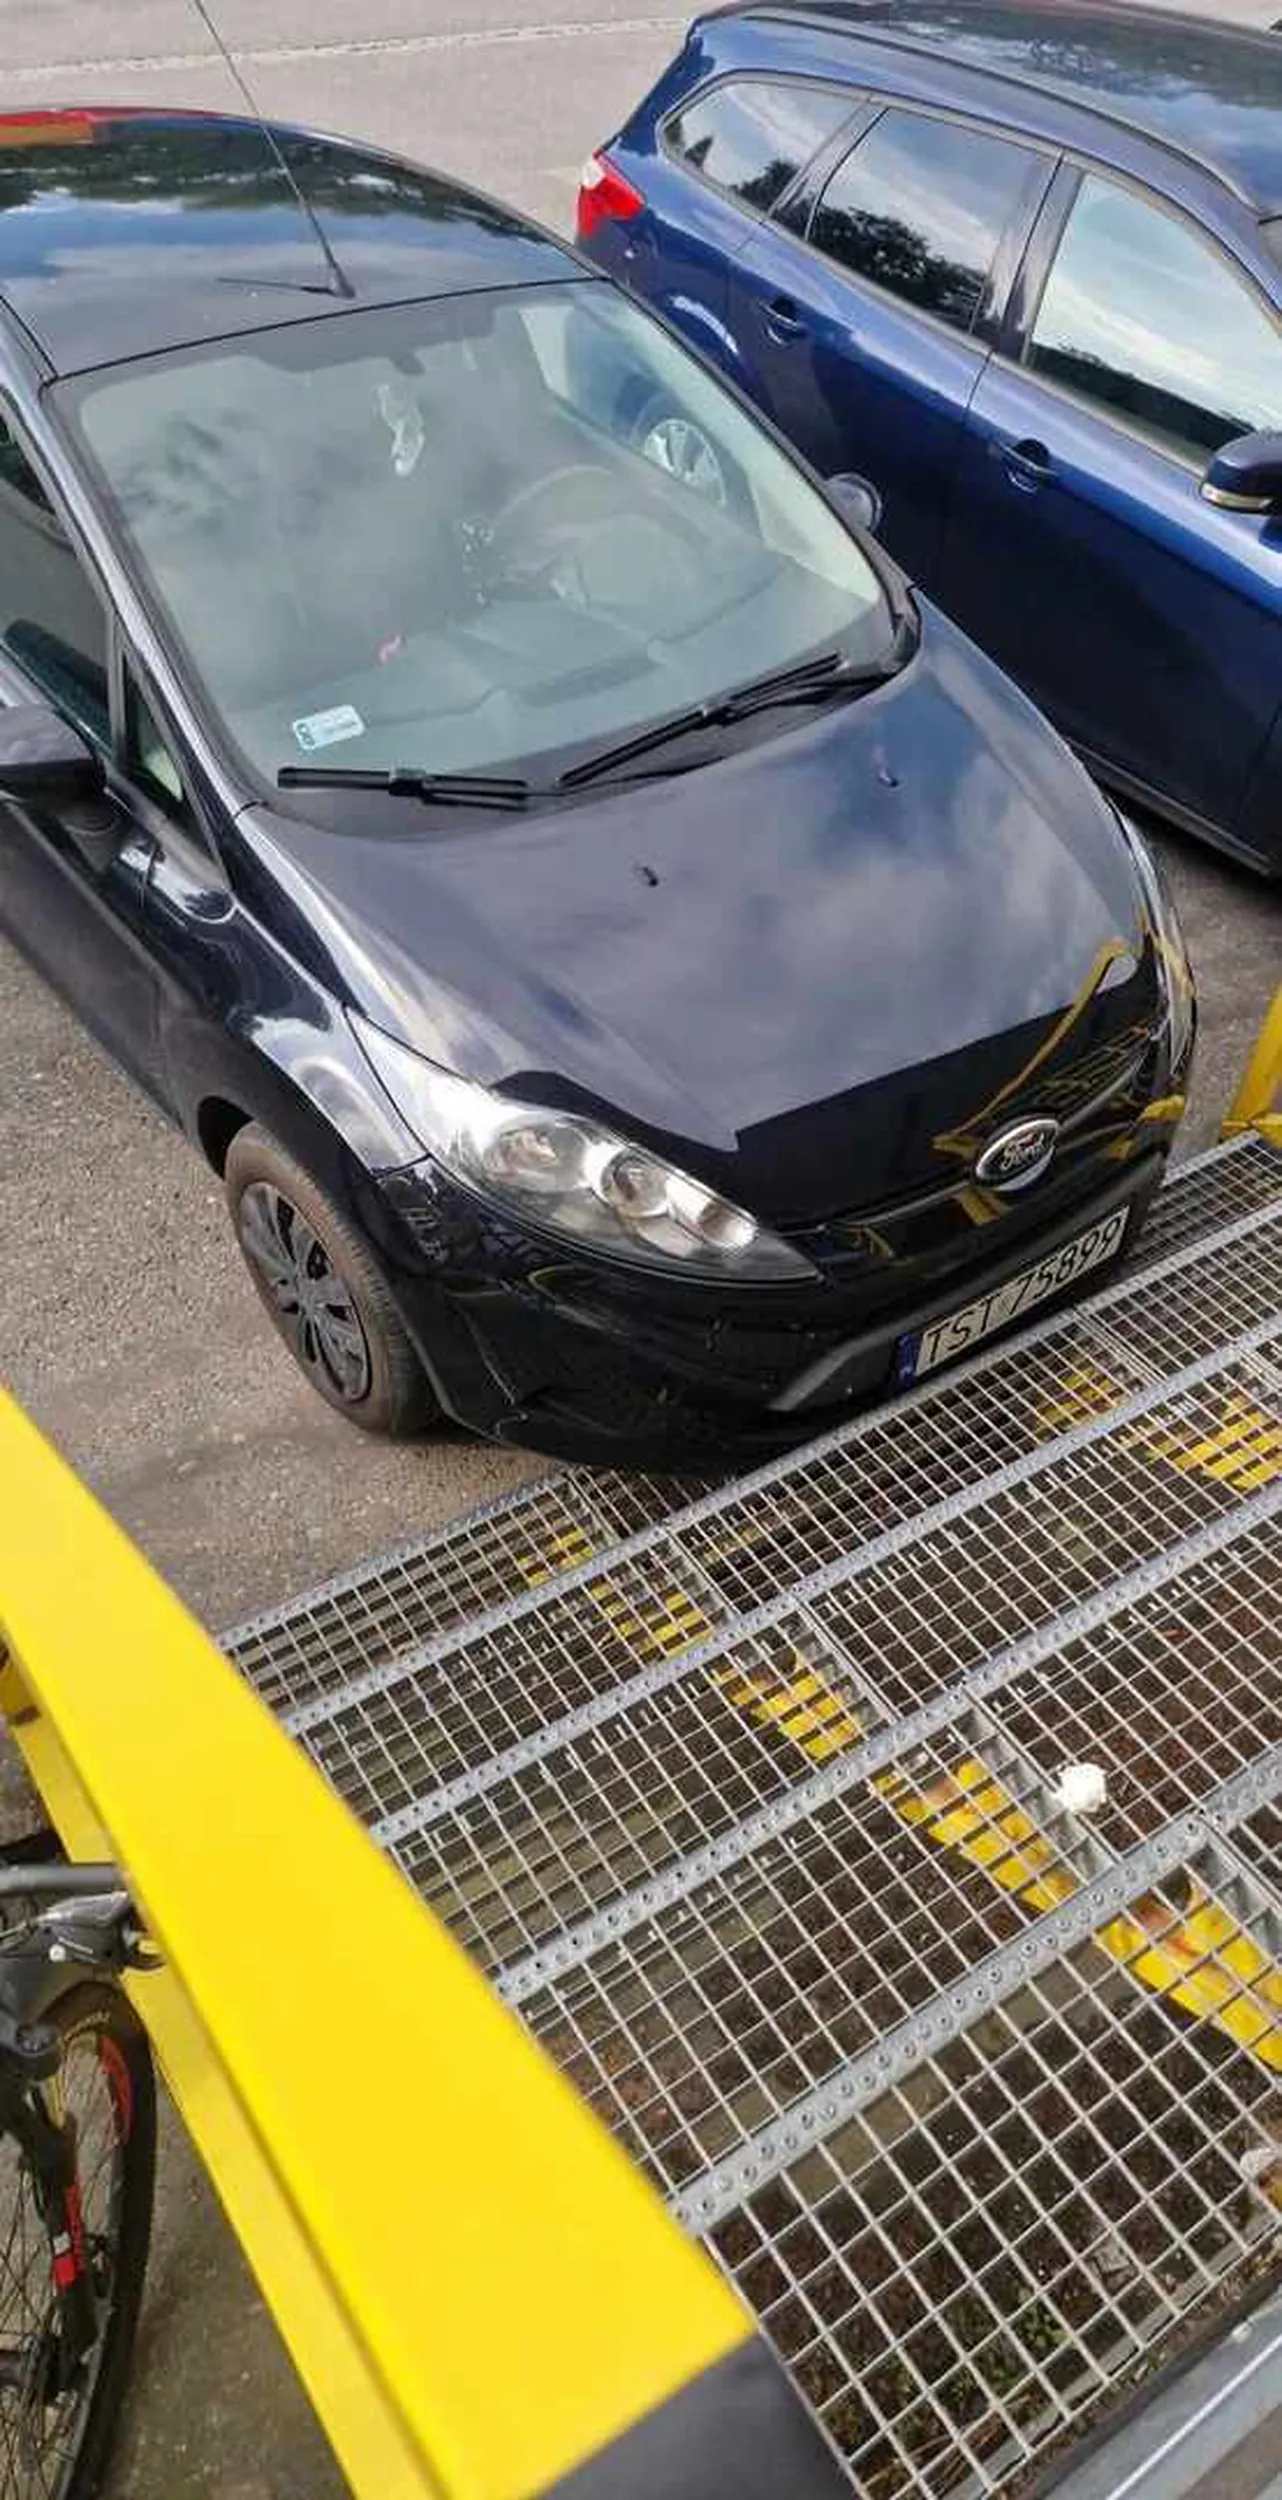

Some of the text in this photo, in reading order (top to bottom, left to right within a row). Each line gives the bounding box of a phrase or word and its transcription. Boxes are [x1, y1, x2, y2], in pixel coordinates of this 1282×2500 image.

[1000, 1131, 1046, 1172] Ford
[927, 1217, 1122, 1363] TST 75899
